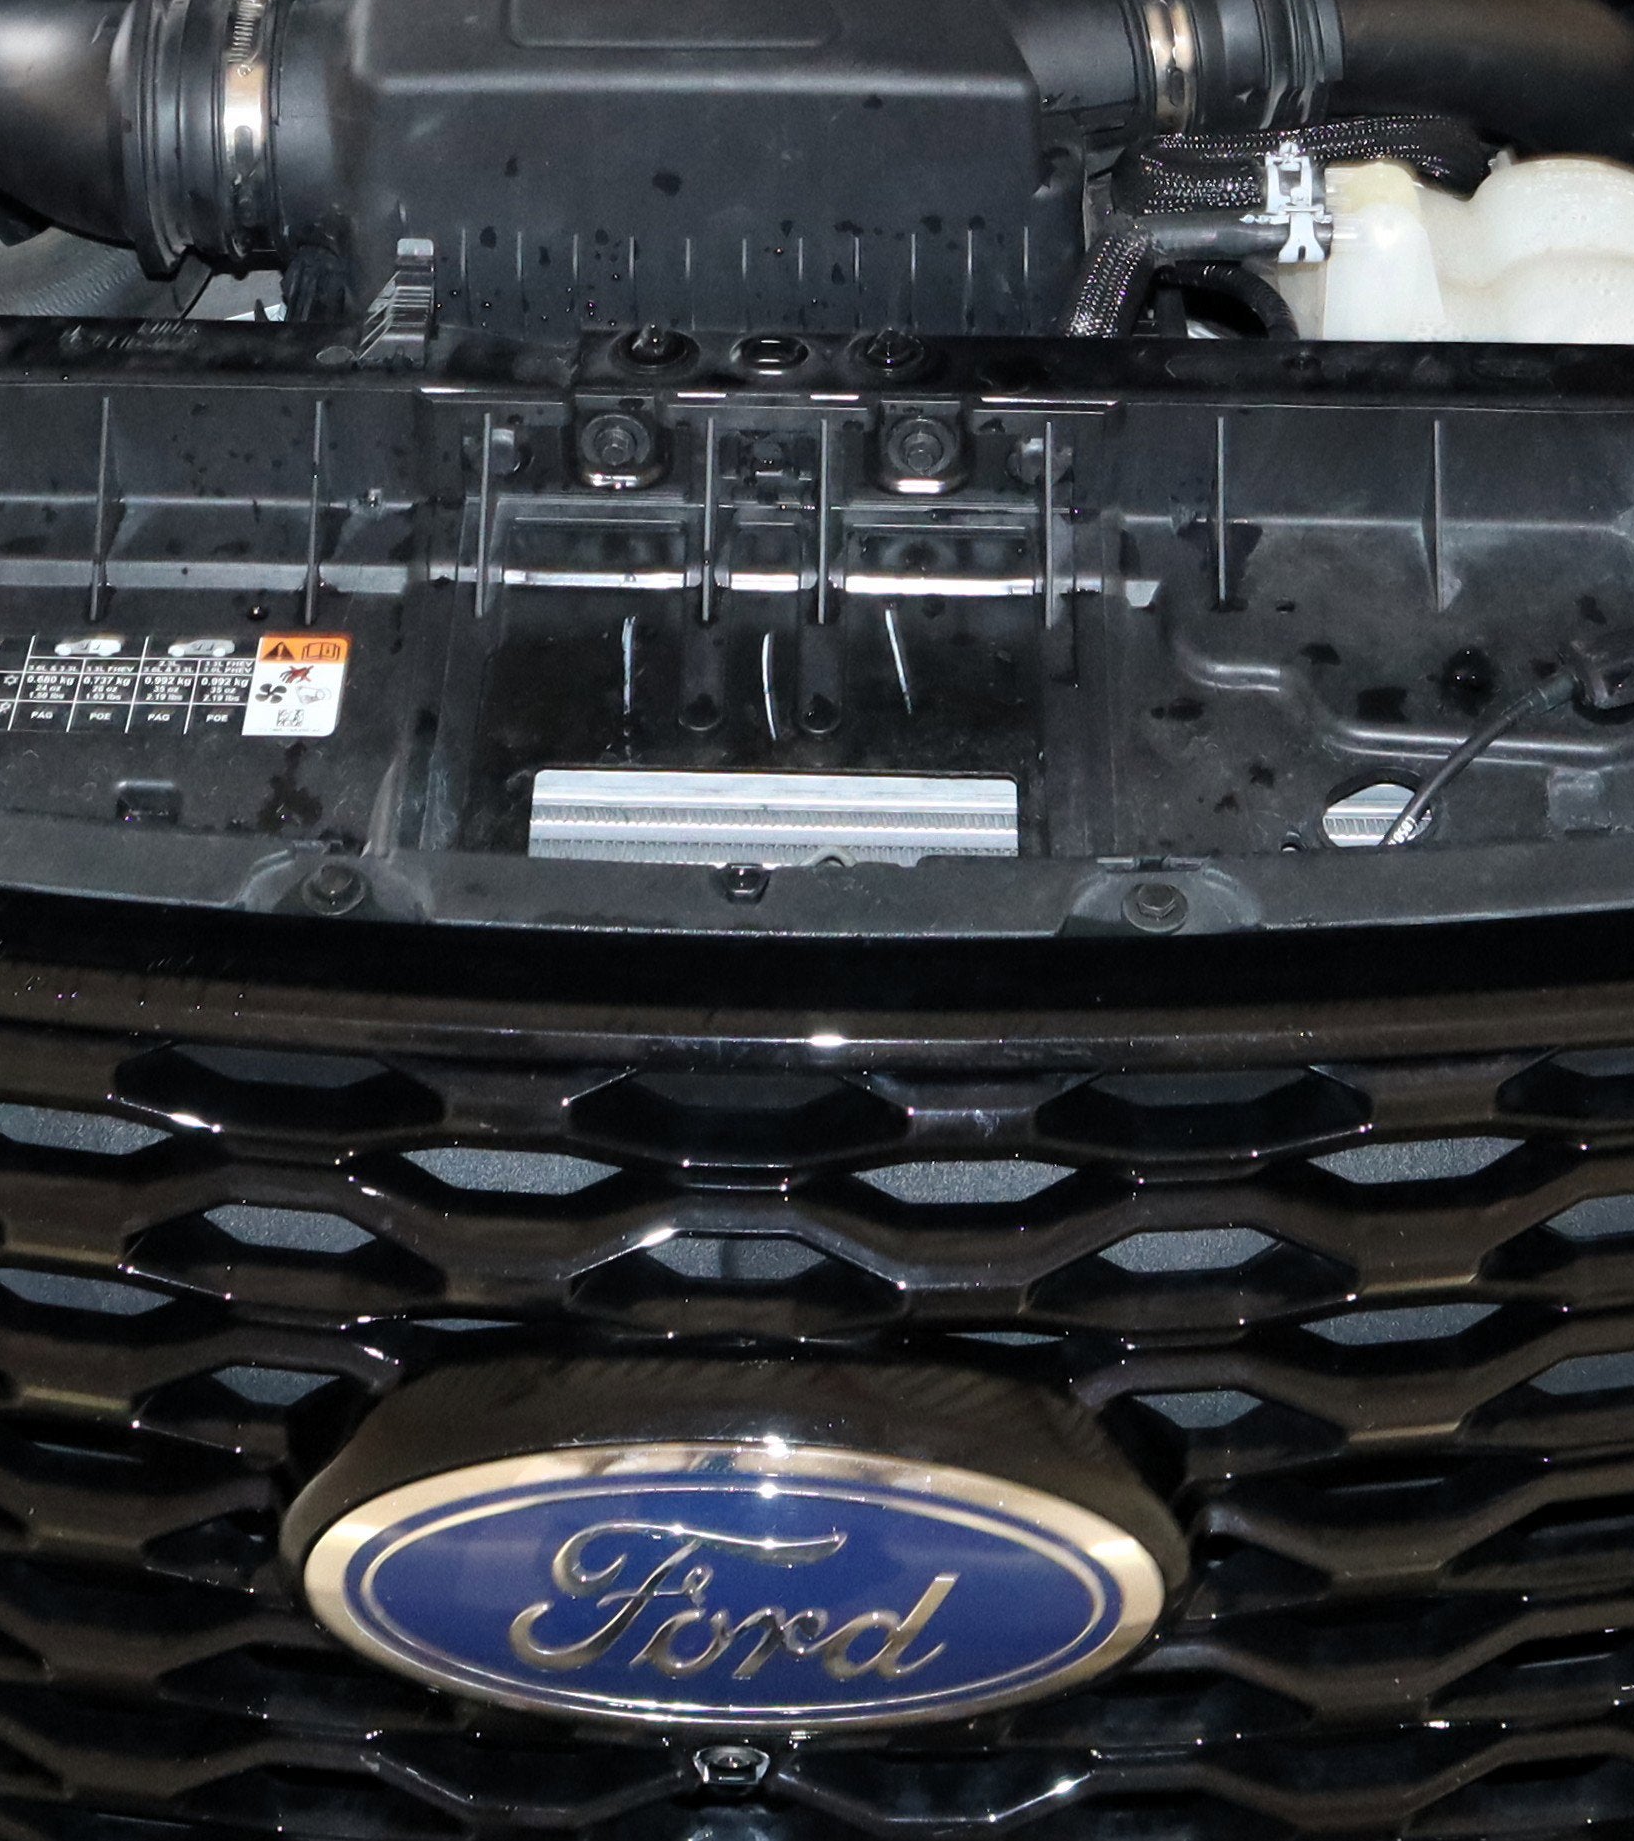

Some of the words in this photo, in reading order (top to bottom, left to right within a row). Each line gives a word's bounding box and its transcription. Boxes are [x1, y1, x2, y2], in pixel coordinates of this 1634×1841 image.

[59, 676, 75, 686] kg
[83, 677, 114, 685] 0.737
[115, 677, 131, 687] kg
[144, 676, 174, 685] 0.992
[176, 677, 192, 687] kg
[233, 678, 249, 688] kg
[30, 711, 54, 719] PAG
[89, 712, 112, 720] POE
[508, 1520, 958, 1683] Ford
